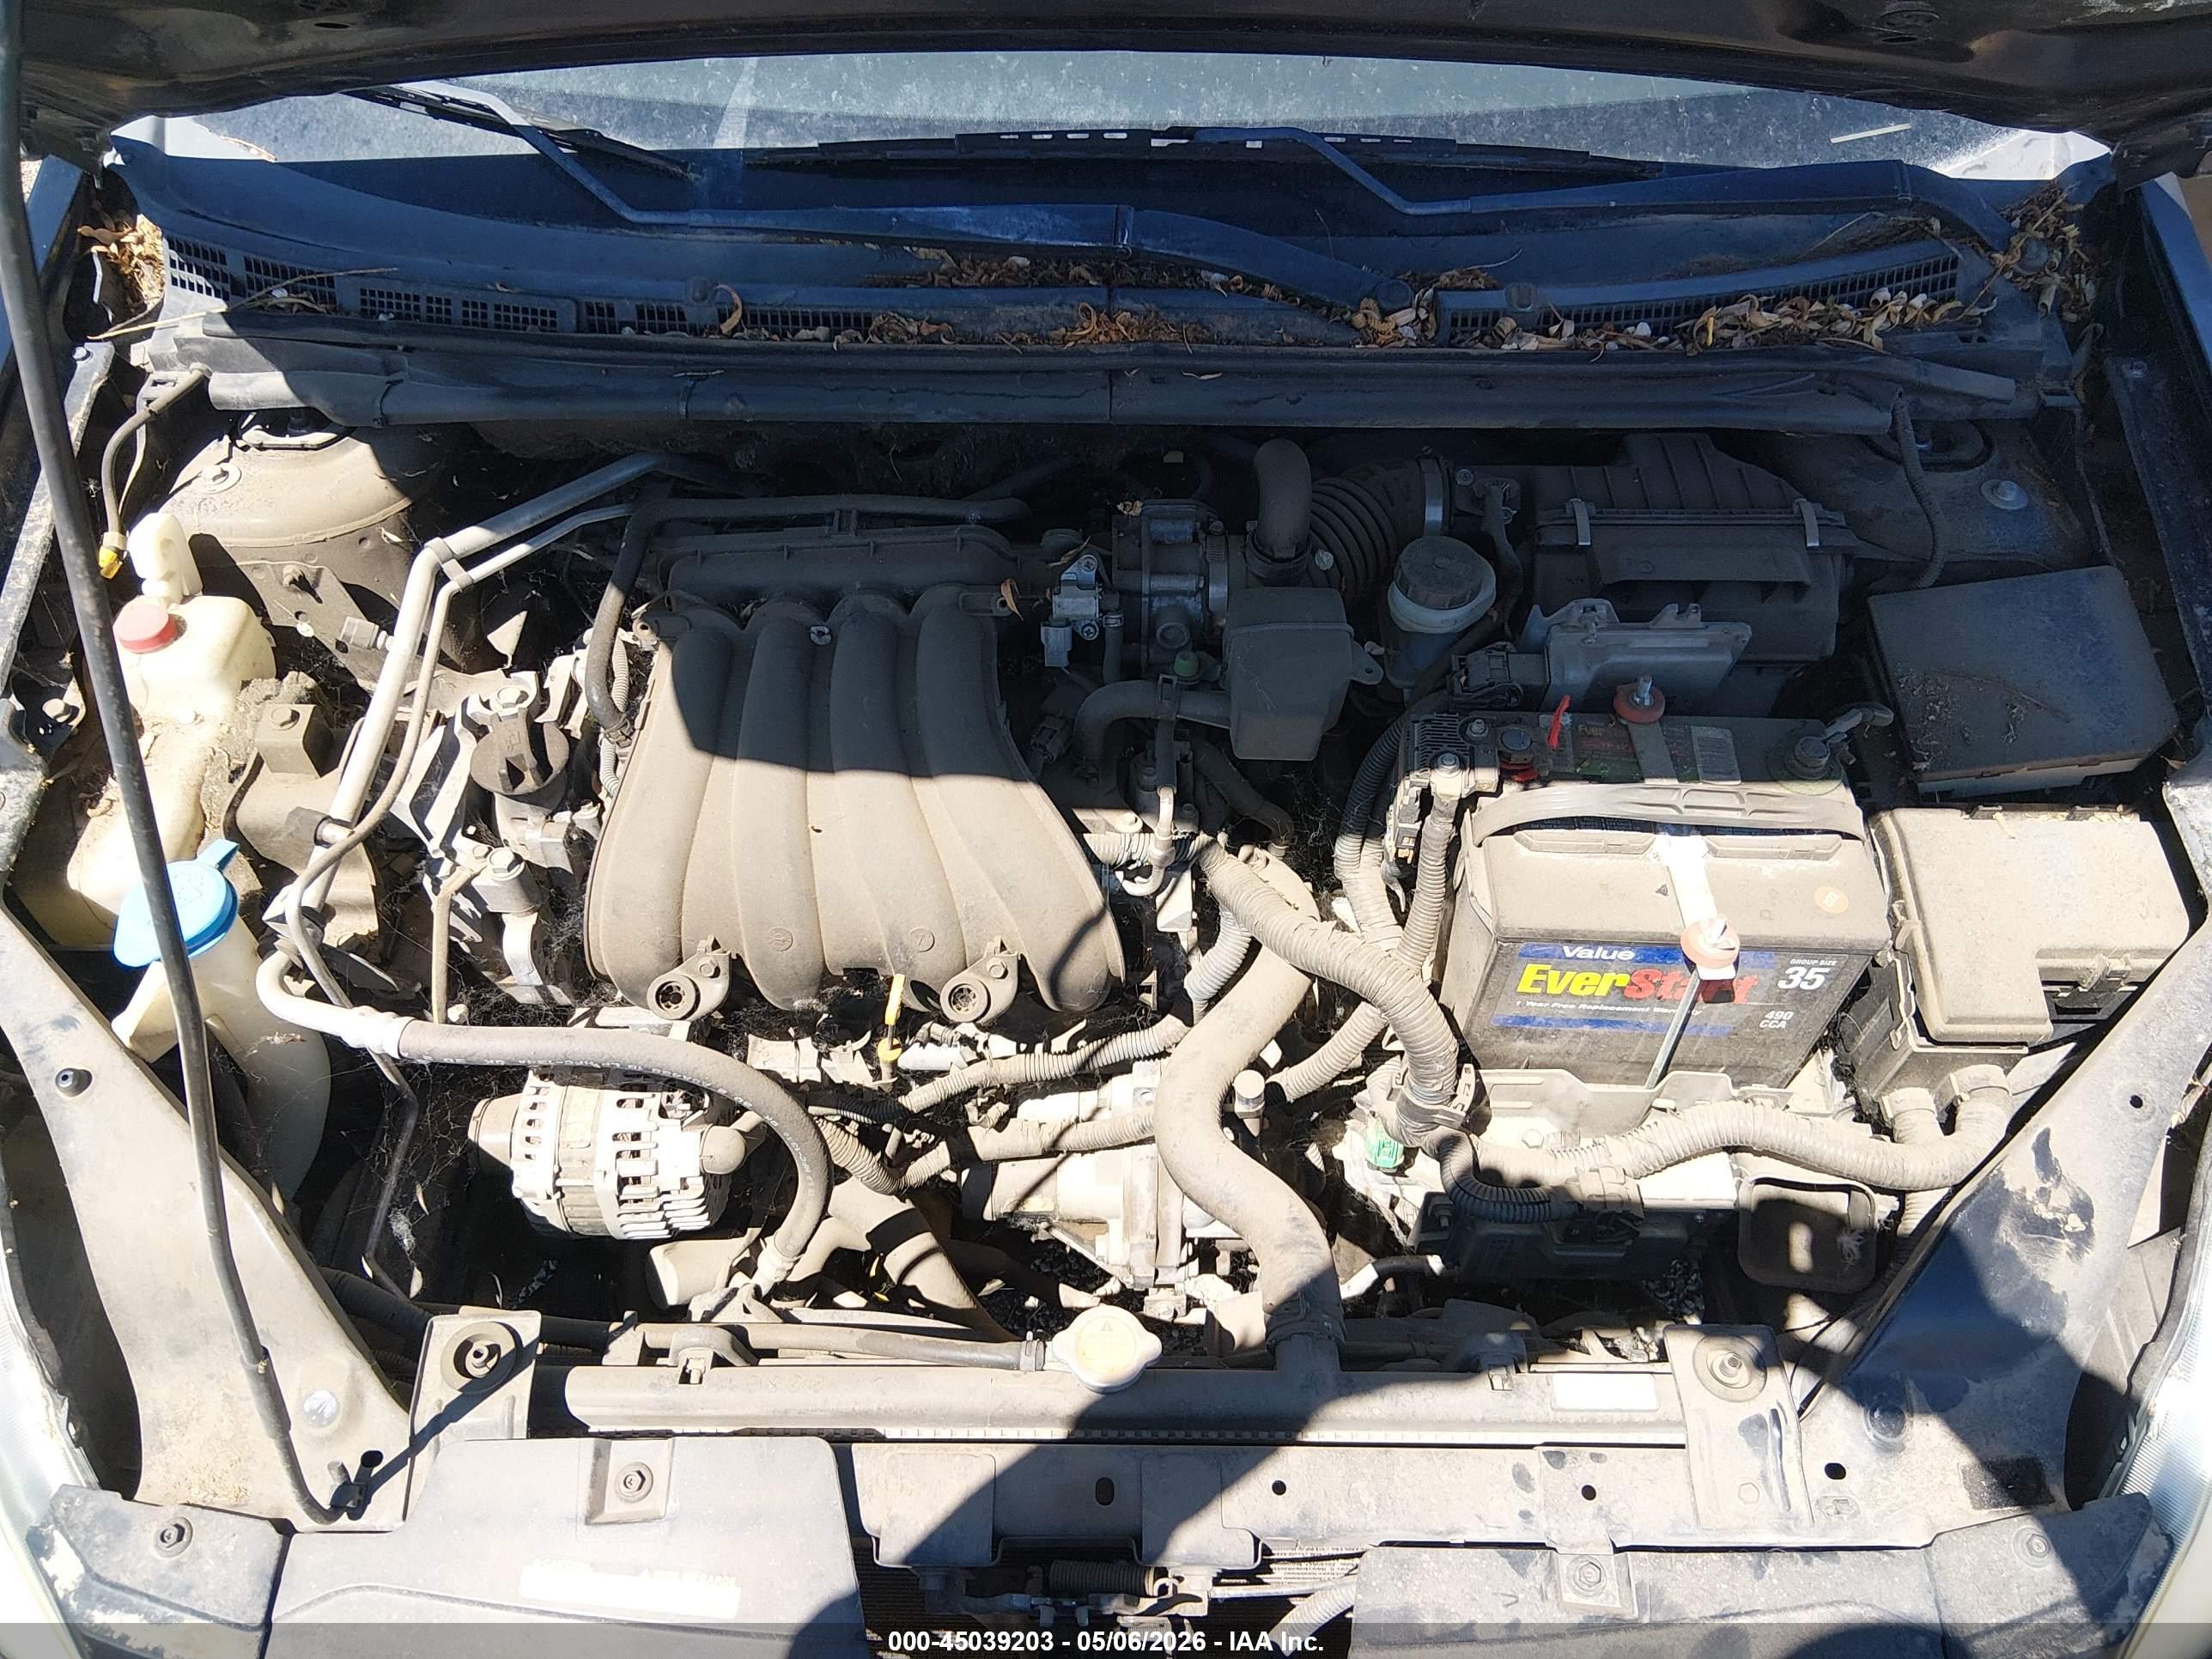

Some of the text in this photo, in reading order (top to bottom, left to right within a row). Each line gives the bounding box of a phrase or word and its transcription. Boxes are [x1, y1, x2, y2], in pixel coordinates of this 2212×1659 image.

[1563, 945, 1635, 960] Value
[1777, 966, 1832, 991] 35
[1578, 1003, 1650, 1012] Replacement
[1765, 1010, 1794, 1021] 490
[1759, 1019, 1787, 1030] CCA
